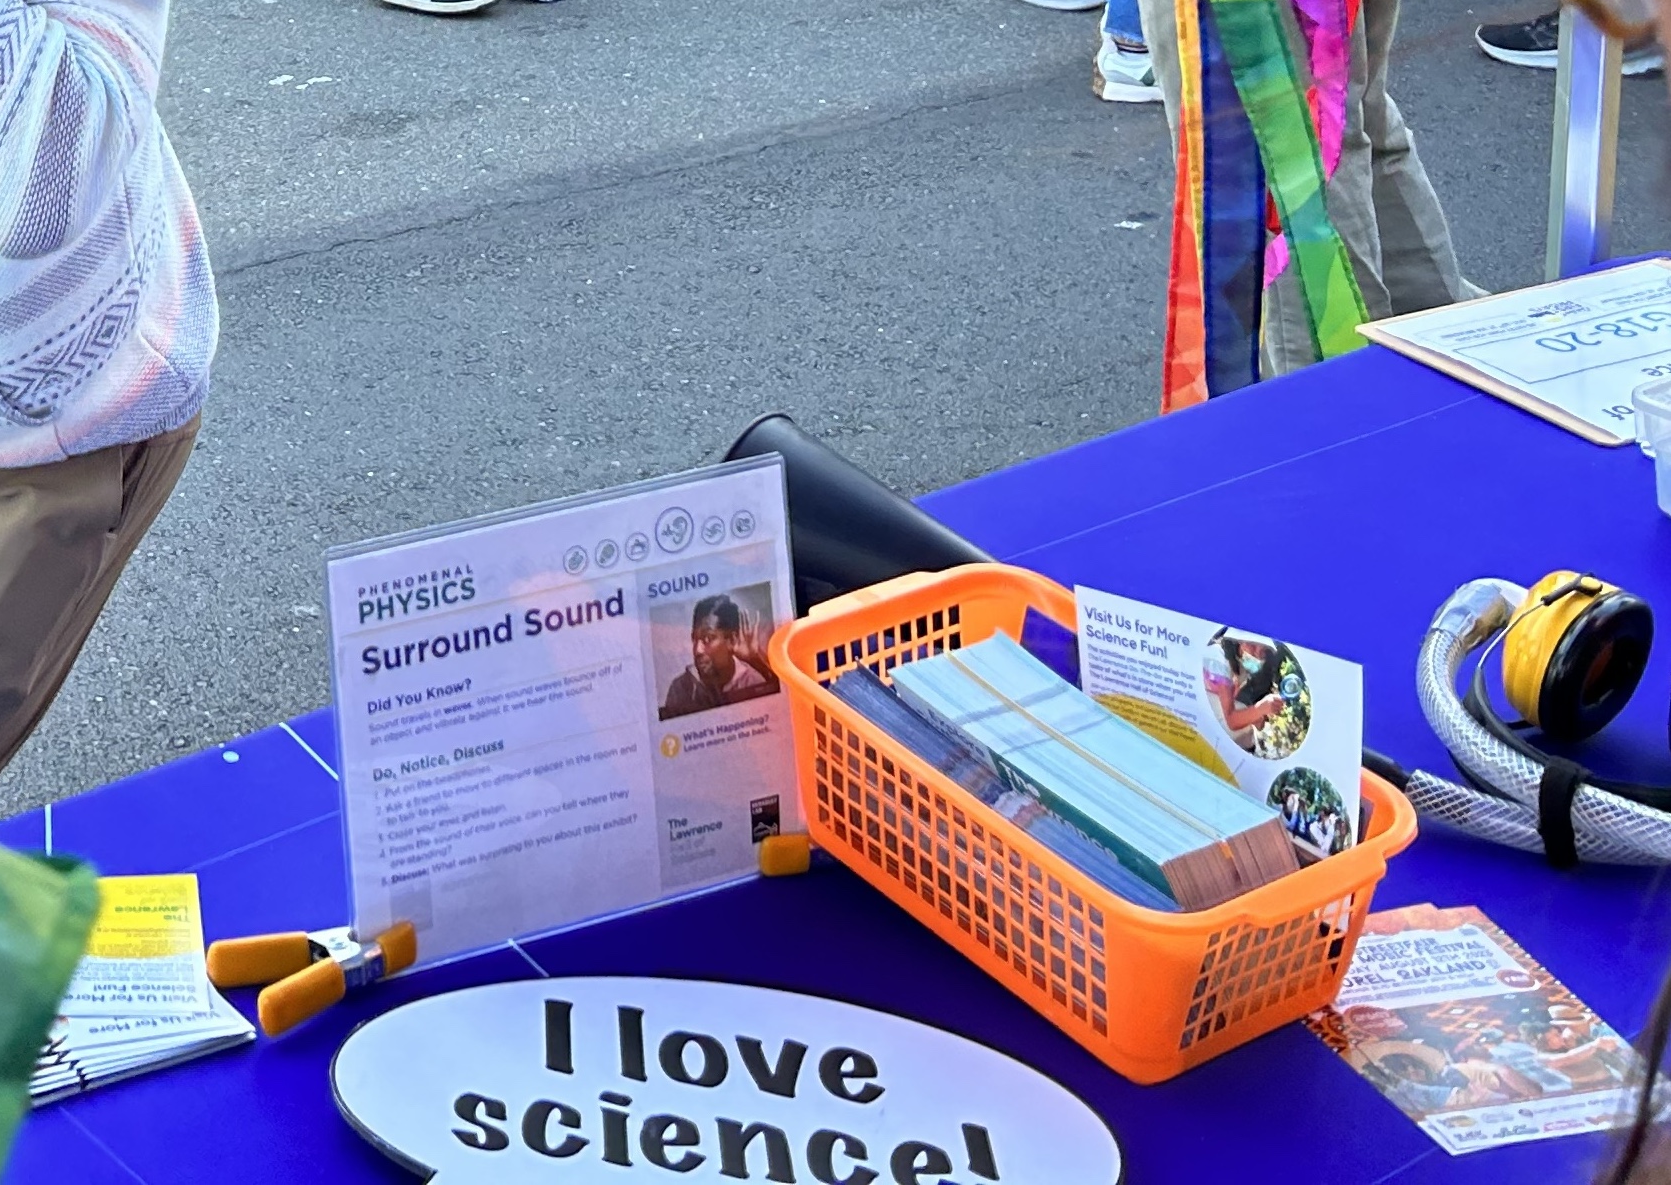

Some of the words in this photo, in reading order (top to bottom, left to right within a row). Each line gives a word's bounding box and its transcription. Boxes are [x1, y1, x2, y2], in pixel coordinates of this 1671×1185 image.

[358, 563, 474, 599] PHENOMENAL
[648, 572, 710, 598] SOUND
[358, 577, 476, 624] PHYSICS
[361, 613, 513, 675] Surround
[525, 588, 625, 637] Sound
[1084, 604, 1113, 625] Visit
[1115, 614, 1132, 631] Us
[1135, 619, 1154, 635] for
[1156, 625, 1190, 647] More
[1086, 624, 1137, 650] Science
[1140, 639, 1168, 660] Fun!
[367, 697, 391, 715] Did
[395, 692, 422, 707] You
[426, 677, 472, 700] Know?
[683, 727, 714, 743] What's
[716, 714, 770, 735] Happening?
[706, 736, 726, 748] more
[373, 767, 397, 782] Do,
[400, 754, 450, 775] Notice,
[454, 739, 504, 762] Discuss
[620, 743, 637, 755] and
[579, 794, 608, 807] where
[609, 789, 630, 802] they
[602, 813, 638, 831] exhibit?
[668, 817, 688, 831] The
[670, 821, 723, 842] Lawrence
[88, 1022, 131, 1034] More
[543, 998, 574, 1075] I
[617, 1004, 886, 1106] love
[451, 1090, 1000, 1185] science!
